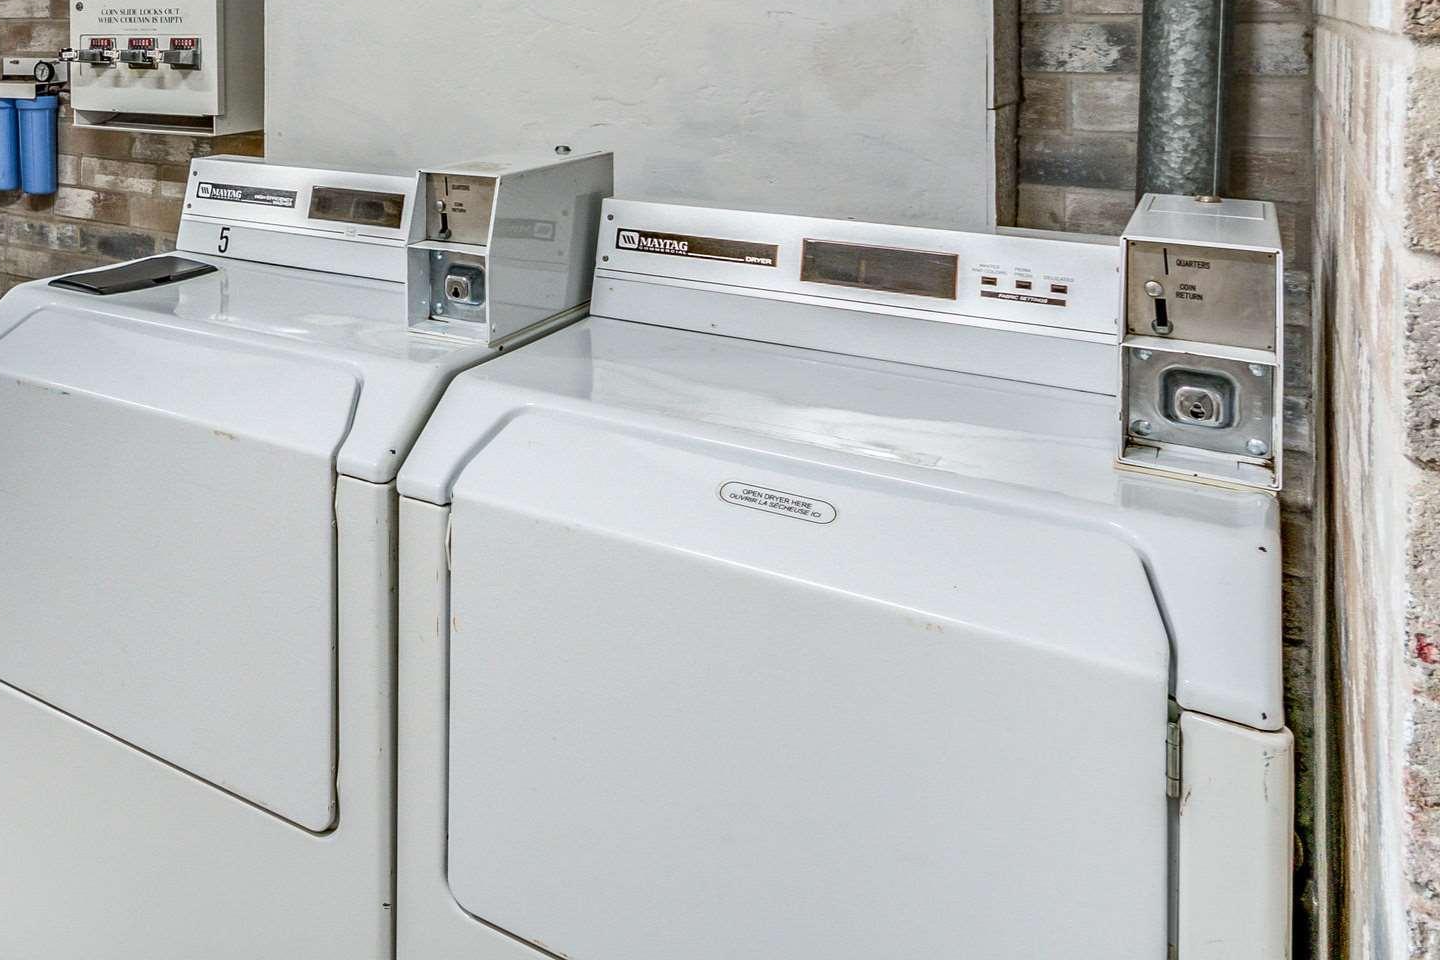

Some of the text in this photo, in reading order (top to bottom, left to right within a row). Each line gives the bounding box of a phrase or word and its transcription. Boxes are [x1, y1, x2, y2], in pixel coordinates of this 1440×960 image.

[140, 8, 163, 16] LOCKS
[164, 8, 180, 16] OUT
[98, 16, 119, 24] WHEN
[120, 16, 150, 24] COLUMN
[160, 16, 184, 24] EMPTY
[211, 188, 242, 199] MAYTAG
[218, 227, 230, 253] 5
[639, 237, 688, 252] MAYTAG
[745, 256, 772, 265] DRYER
[1176, 258, 1210, 270] QUARTERS
[1179, 284, 1196, 292] COIN
[1176, 291, 1203, 301] RETURN
[729, 493, 757, 504] OUVRIR
[742, 488, 812, 510] OPEN DRYER HERE
